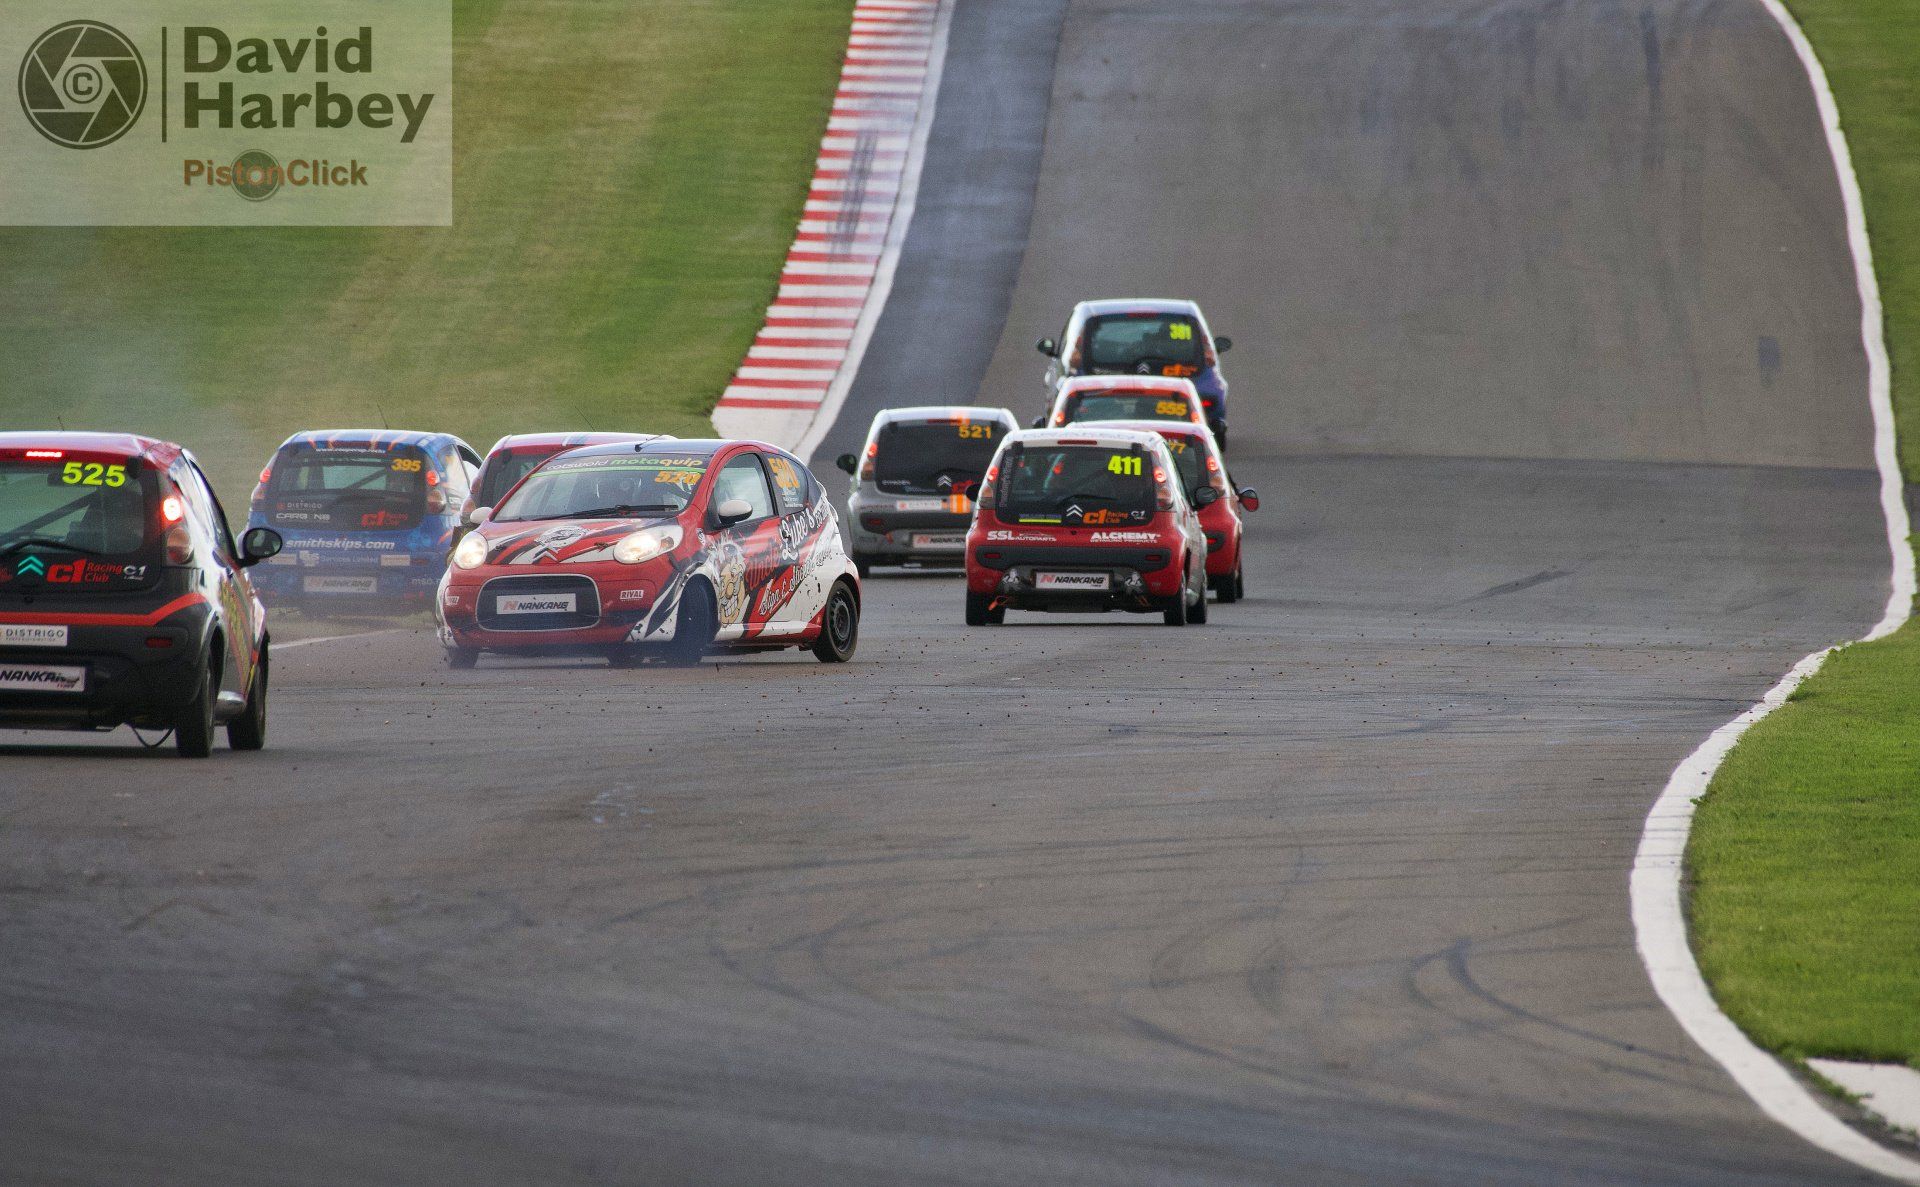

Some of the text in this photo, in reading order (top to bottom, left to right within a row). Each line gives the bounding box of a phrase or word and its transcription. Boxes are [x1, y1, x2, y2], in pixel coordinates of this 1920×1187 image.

[958, 424, 992, 439] 521
[390, 458, 422, 472] 395
[610, 457, 703, 467] motaquip
[1108, 455, 1142, 476] 411
[62, 462, 126, 487] 525
[987, 530, 1014, 541] SSL
[1090, 532, 1157, 540] ALCHEMY
[285, 538, 395, 551] smithskips.com
[1054, 576, 1105, 585] NANKANG
[621, 590, 643, 599] RIVAL
[517, 601, 569, 610] NANKANG
[5, 628, 65, 638] DISTRIGO
